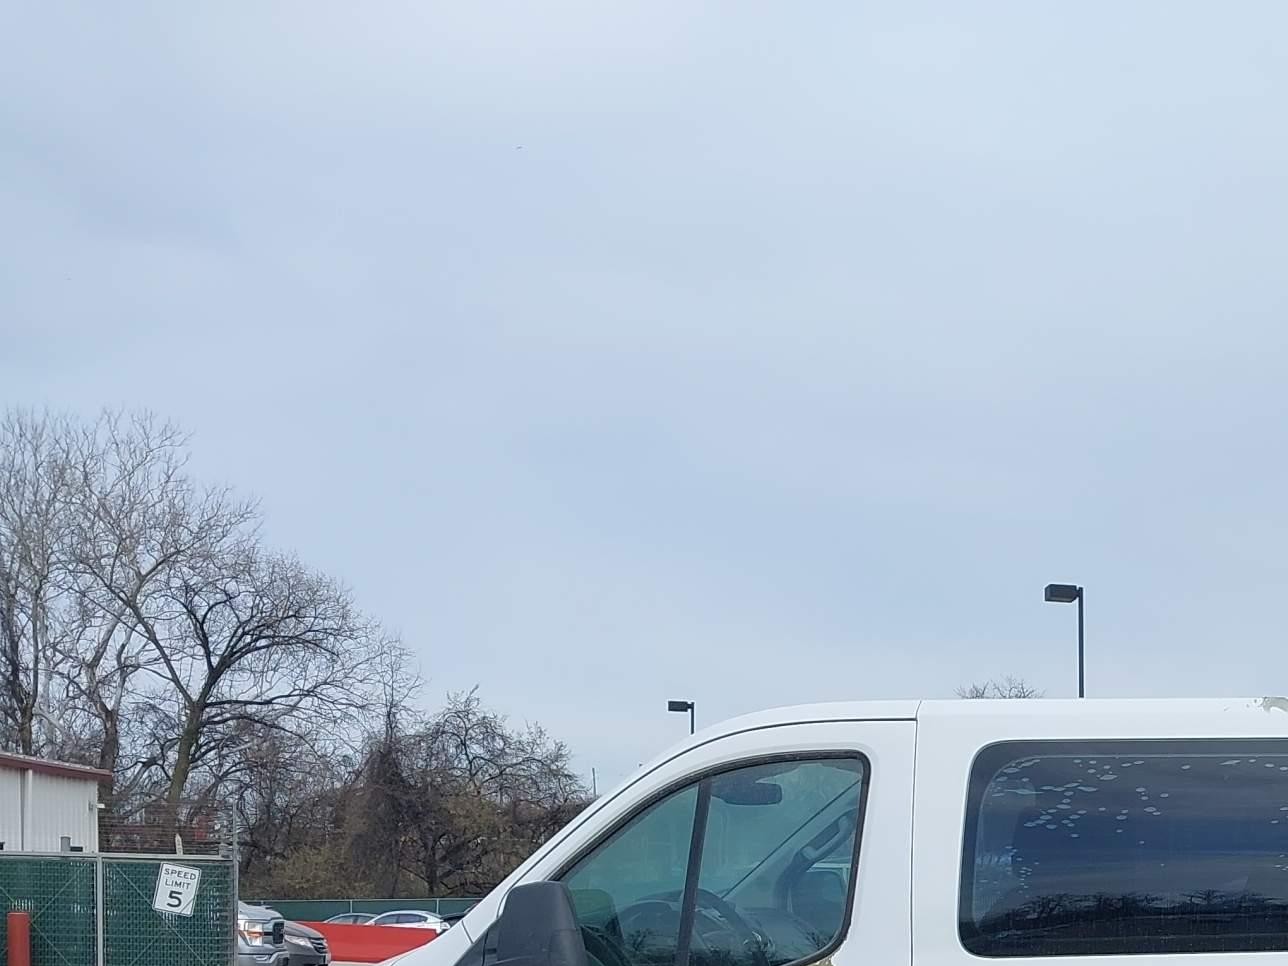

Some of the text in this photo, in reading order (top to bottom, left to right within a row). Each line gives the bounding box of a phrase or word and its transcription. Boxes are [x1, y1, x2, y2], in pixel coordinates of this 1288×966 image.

[163, 868, 197, 881] SPEED
[164, 878, 192, 890] LIMIT
[166, 890, 183, 908] 5
